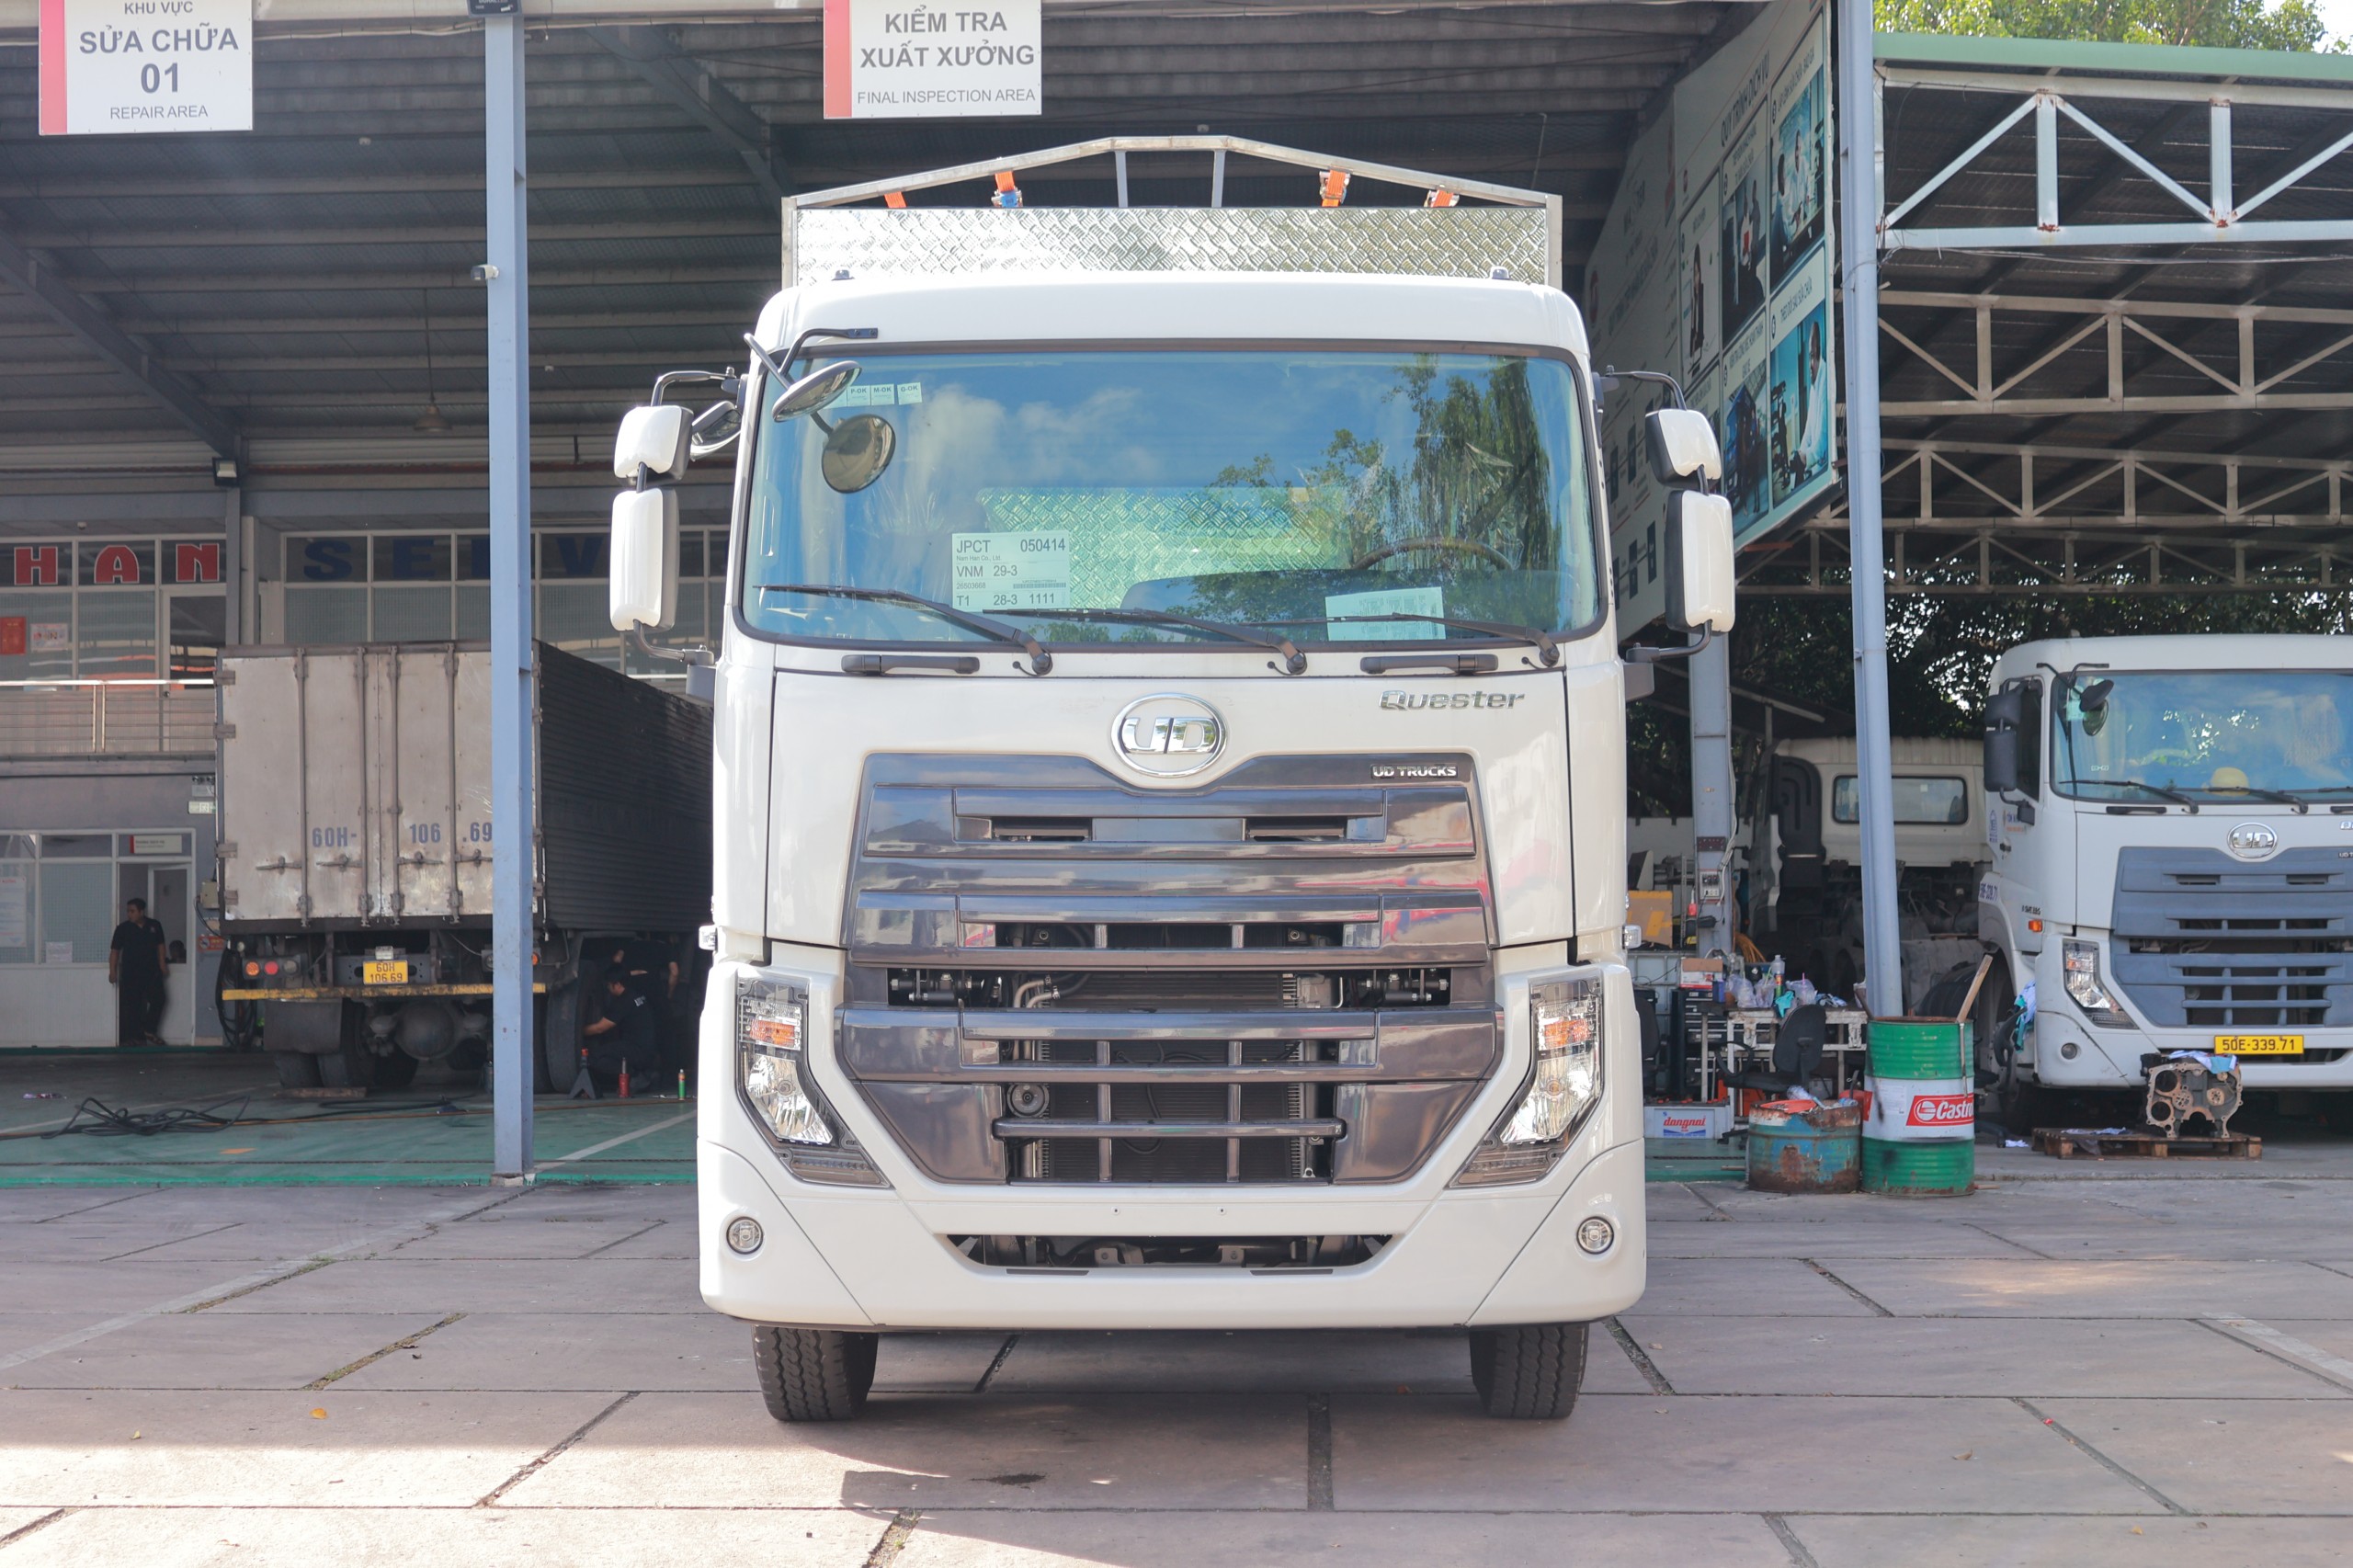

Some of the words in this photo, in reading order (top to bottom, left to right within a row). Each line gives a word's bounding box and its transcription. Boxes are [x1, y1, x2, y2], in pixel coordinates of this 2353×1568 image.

[124, 2, 156, 15] KHU
[160, 1, 194, 16] VỰC
[885, 5, 948, 33] KIỂM
[955, 11, 1007, 32] TRA
[79, 25, 144, 54] SỬA
[152, 22, 239, 52] CHỮA
[860, 40, 930, 68] XUẤT
[937, 39, 1035, 67] XƯỞNG
[141, 62, 178, 94] 01
[858, 91, 900, 104] FINAL
[903, 89, 992, 103] INSPECTION
[995, 88, 1036, 101] AREA
[109, 106, 165, 119] REPAIR
[167, 105, 209, 118] AREA
[956, 540, 991, 553] JPCT
[1019, 538, 1066, 552] 050414
[956, 565, 983, 577] VNM
[993, 564, 1017, 577] 29-3
[956, 595, 970, 607] T1
[993, 594, 1017, 606] 28-3
[1029, 593, 1054, 605] 1111
[1378, 689, 1526, 712] Quester
[1123, 717, 1219, 755] UD
[1372, 766, 1395, 777] UD
[1396, 766, 1457, 777] TRUCKS
[376, 962, 395, 972] 60H
[2222, 1039, 2295, 1051] 50E-339.71
[1936, 1099, 1974, 1120] Castro
